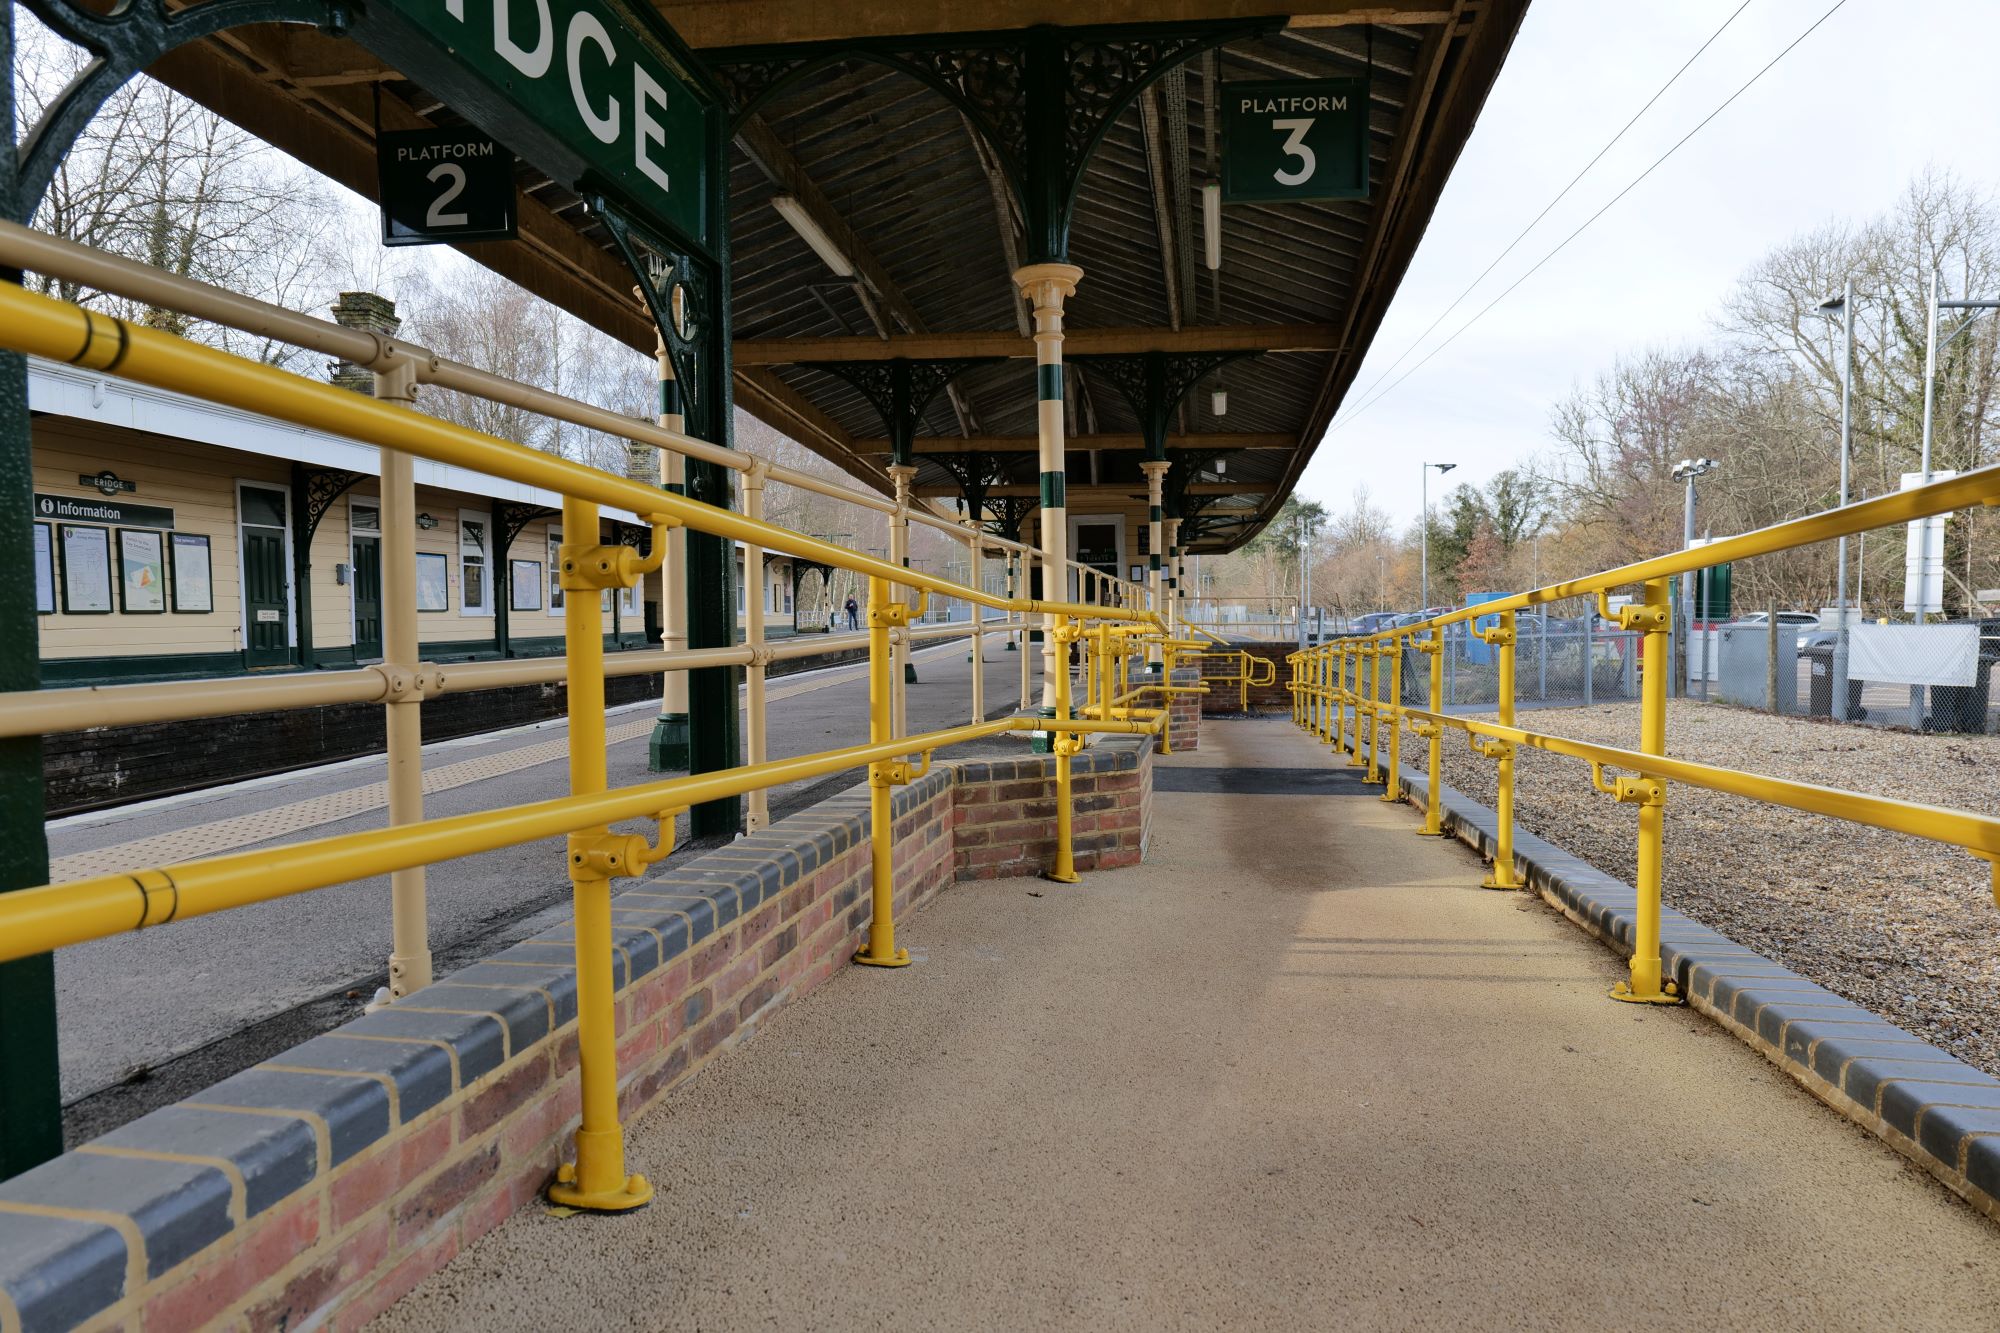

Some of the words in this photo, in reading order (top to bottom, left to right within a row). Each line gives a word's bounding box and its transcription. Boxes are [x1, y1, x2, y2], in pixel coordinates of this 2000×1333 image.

[445, 0, 669, 193] DGE
[1241, 96, 1347, 114] PLATFORM
[397, 141, 493, 161] PLATFORM
[1272, 117, 1317, 186] 3
[425, 162, 468, 228] 2
[94, 477, 124, 489] ERIDGE
[57, 500, 121, 520] Information
